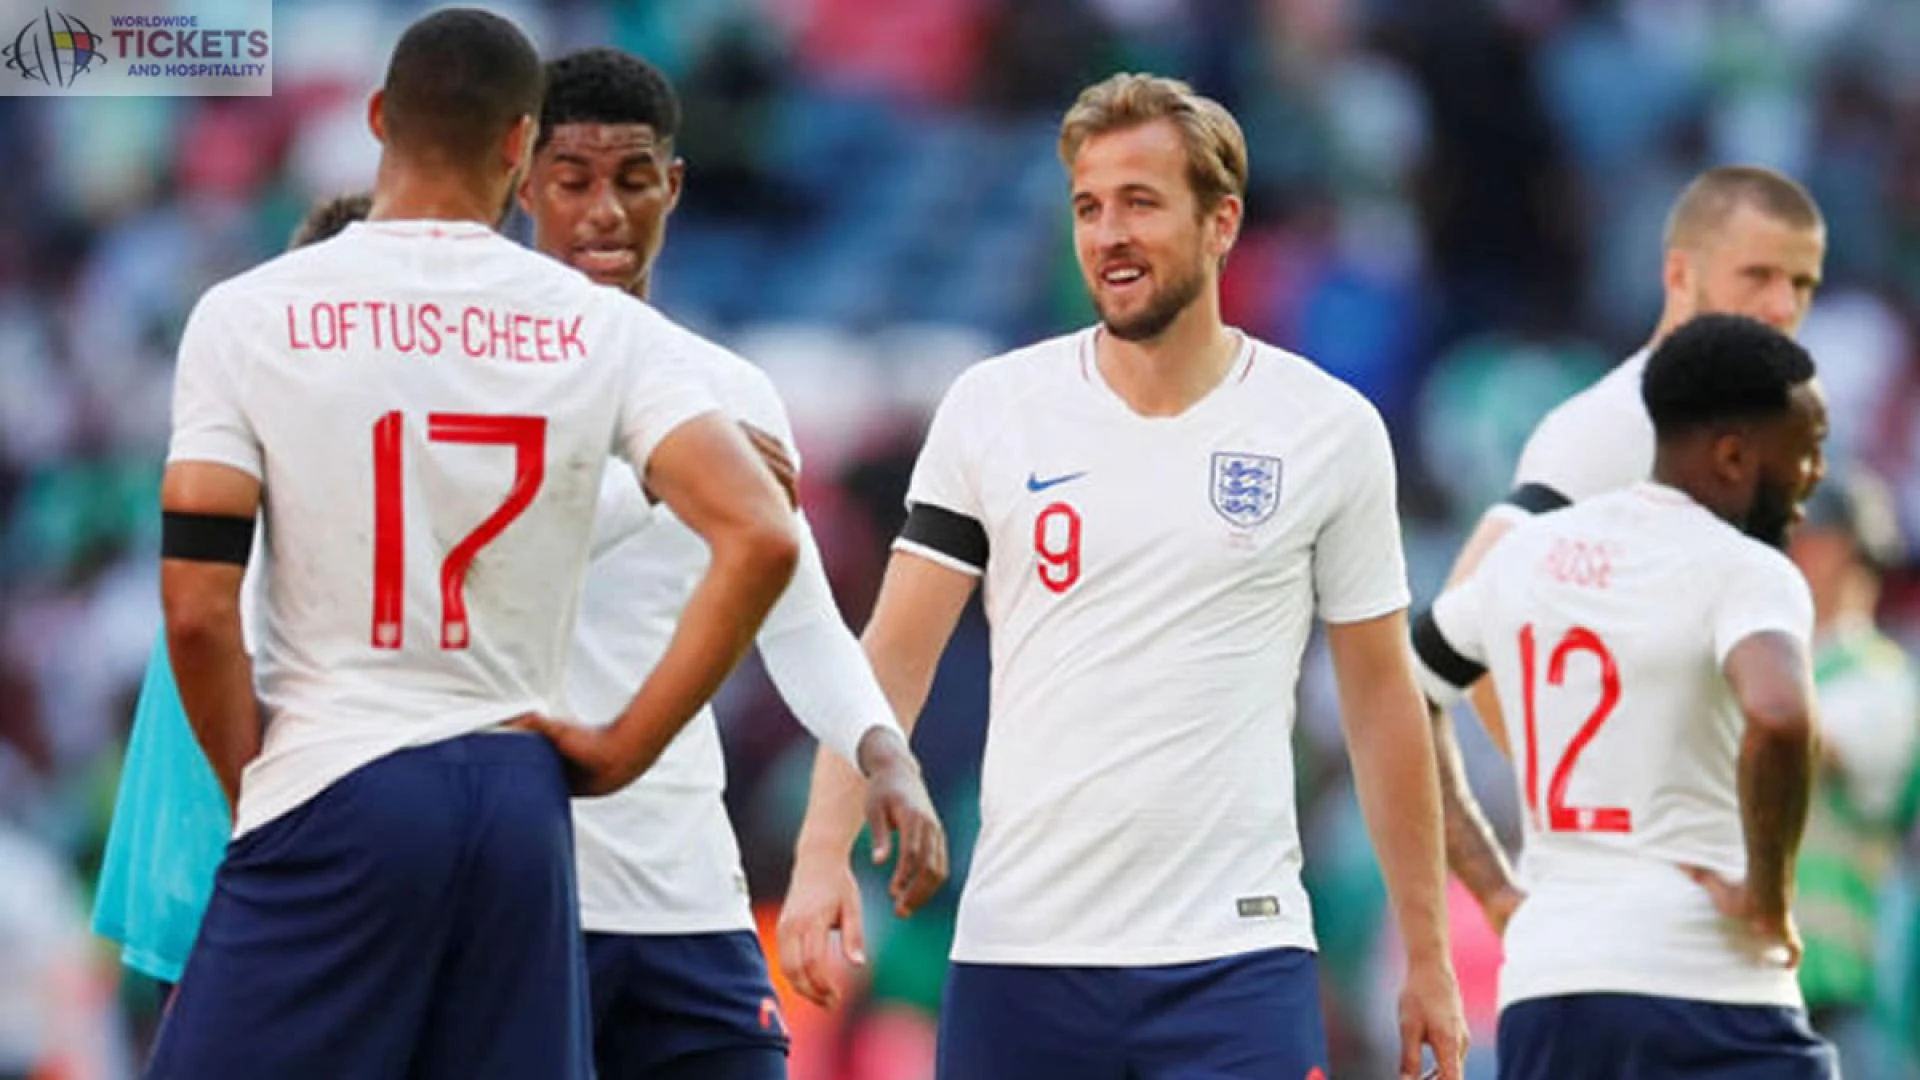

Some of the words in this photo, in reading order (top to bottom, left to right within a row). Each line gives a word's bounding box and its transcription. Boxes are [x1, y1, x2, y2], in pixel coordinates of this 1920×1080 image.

[287, 302, 587, 362] LOFTUS-CHEEK
[371, 409, 547, 650] 17
[1034, 501, 1082, 593] 9
[1518, 622, 1632, 833] 12
